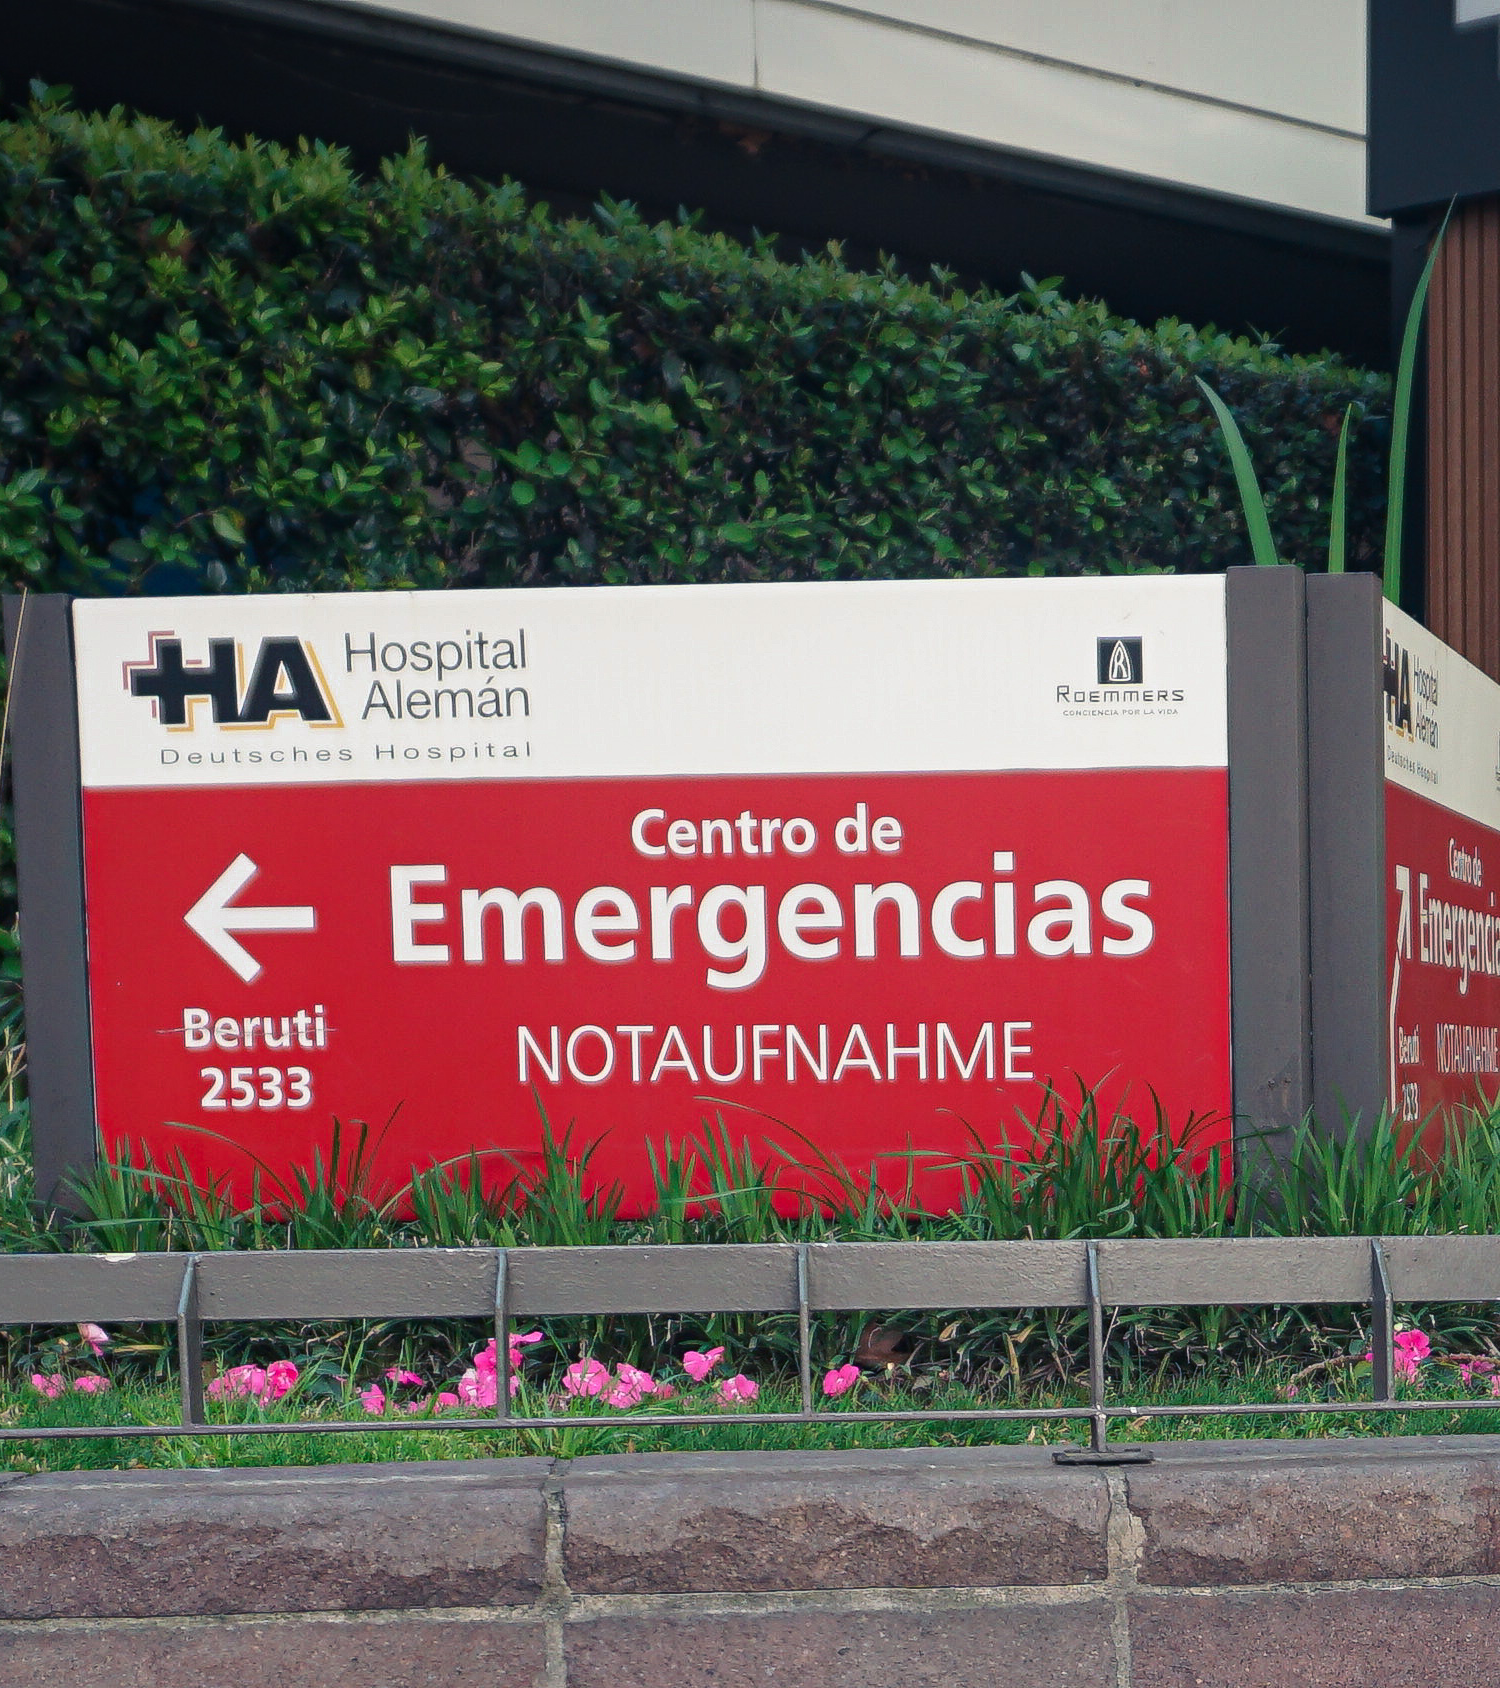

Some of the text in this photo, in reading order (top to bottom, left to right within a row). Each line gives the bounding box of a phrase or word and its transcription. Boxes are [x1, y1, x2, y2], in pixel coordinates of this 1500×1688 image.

[344, 629, 527, 680] Hospital
[128, 634, 338, 728] HA
[361, 675, 531, 720] Alemán
[1414, 655, 1438, 709] Hospital
[160, 741, 531, 765] Deutsches Hospital
[630, 802, 903, 856] Centro de
[1449, 837, 1482, 887] Centro de
[389, 850, 1154, 990] Emergencias
[183, 1004, 325, 1049] Beruti
[1436, 1023, 1499, 1073] NOTAUFNAHME
[516, 1020, 1035, 1084] NOTAUFNAHME
[200, 1066, 313, 1108] 2533
